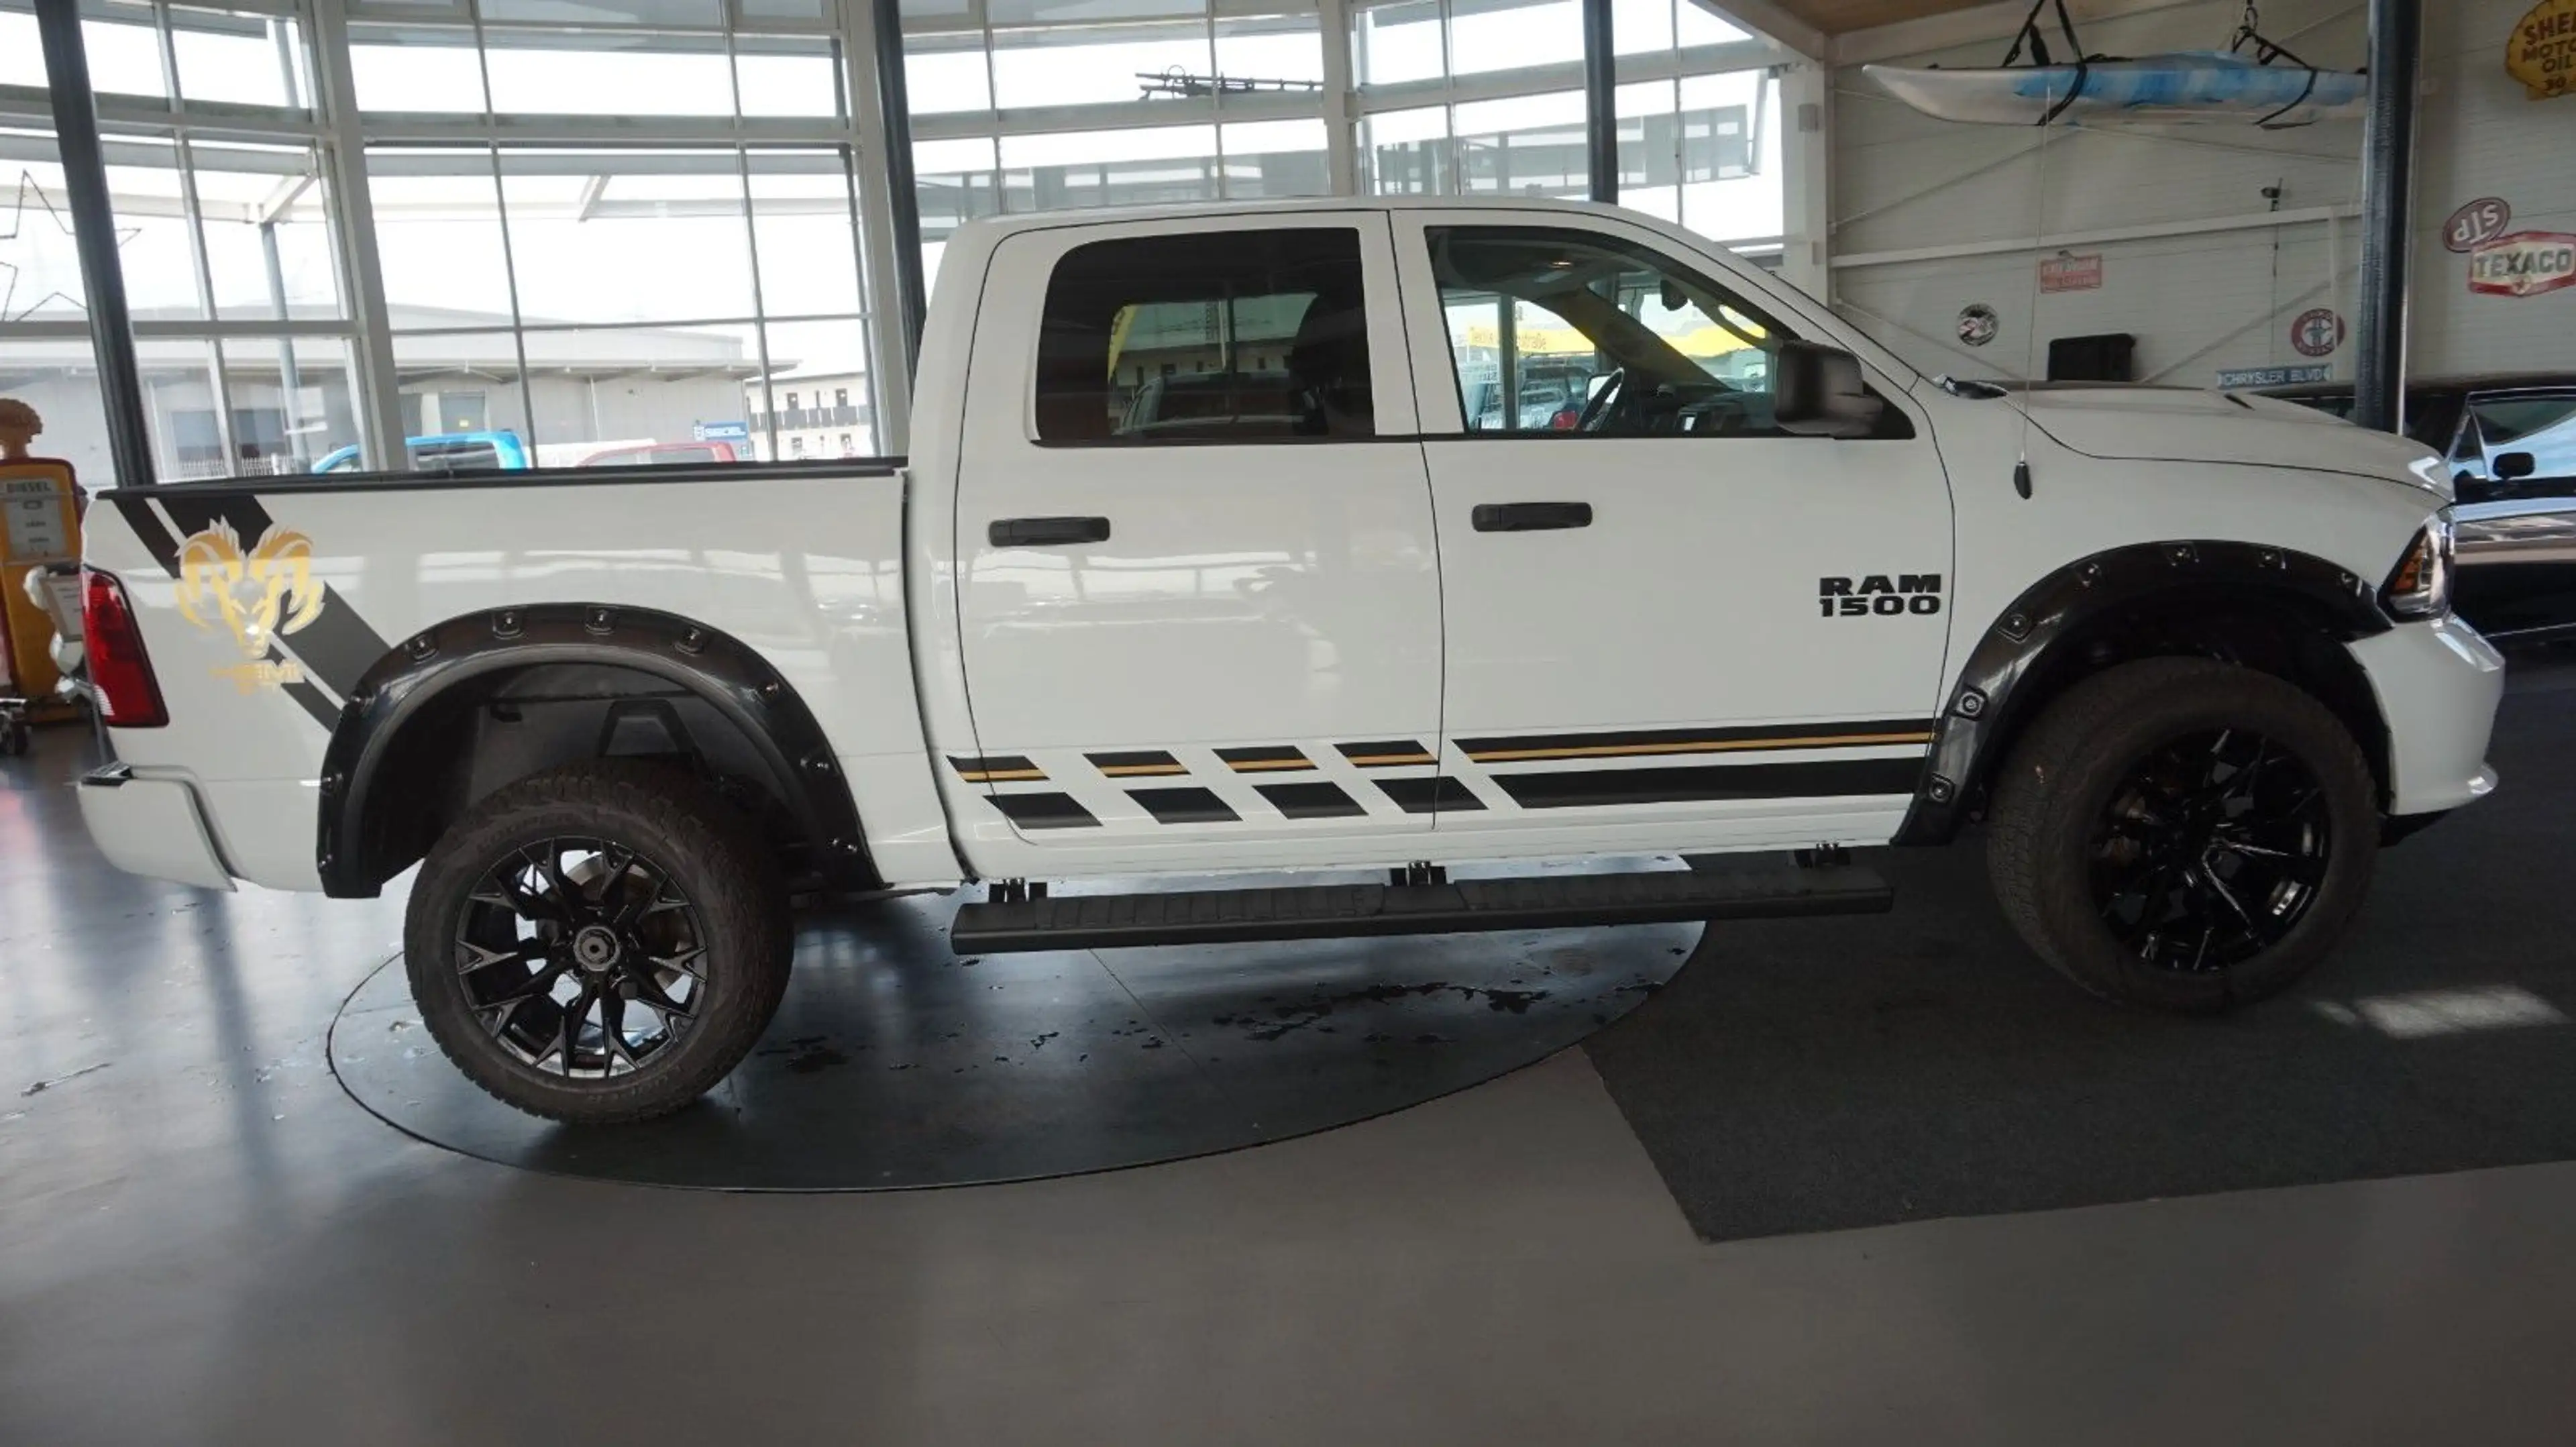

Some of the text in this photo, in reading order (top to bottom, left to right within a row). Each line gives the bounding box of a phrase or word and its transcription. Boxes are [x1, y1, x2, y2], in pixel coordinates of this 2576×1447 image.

[2542, 54, 2573, 72] OIL
[2453, 203, 2500, 244] STP
[2475, 248, 2571, 277] TEXACO
[2224, 368, 2322, 386] CHRYSLER BLVD
[1819, 574, 1941, 596] RAM
[1819, 595, 1940, 617] 1500
